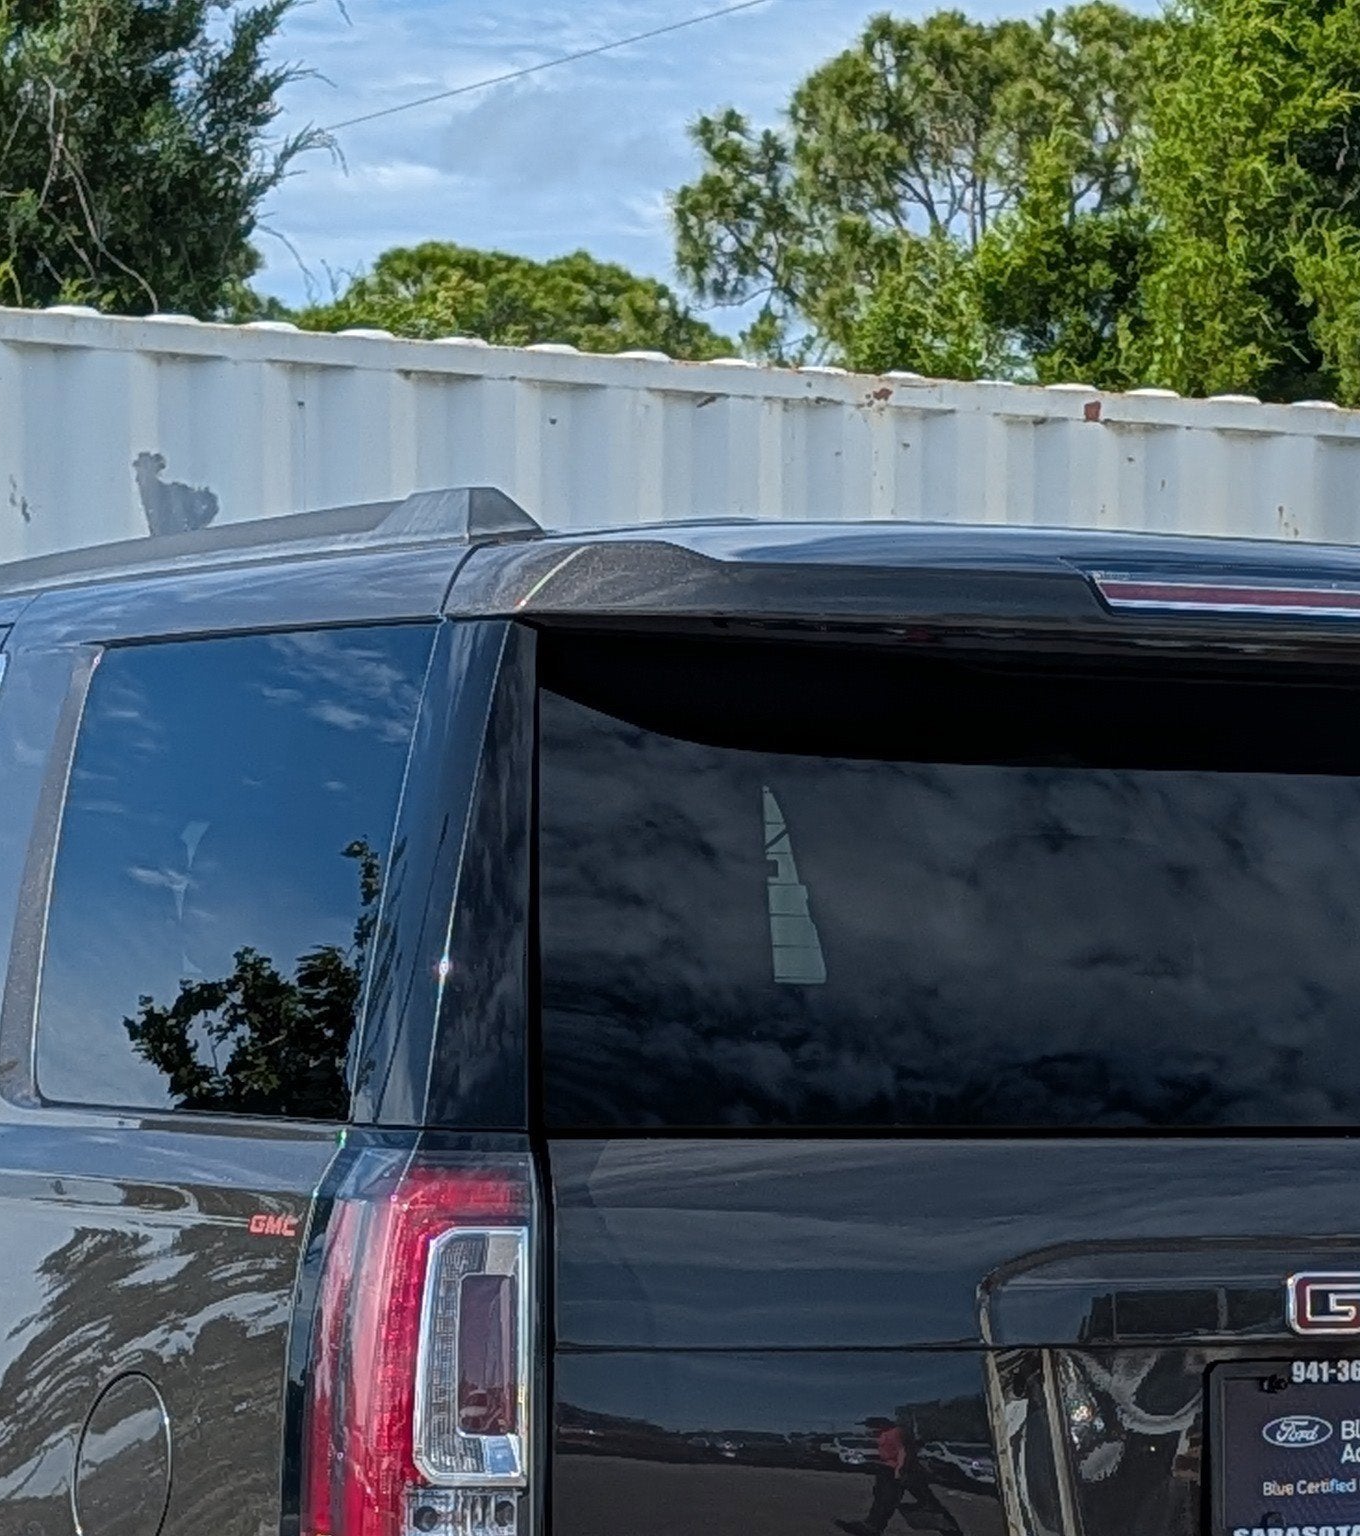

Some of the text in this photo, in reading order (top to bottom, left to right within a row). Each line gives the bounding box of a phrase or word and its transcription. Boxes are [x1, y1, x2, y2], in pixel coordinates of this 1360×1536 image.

[249, 1214, 299, 1237] GMC
[1263, 1480, 1294, 1496] Blue
[1296, 1478, 1356, 1495] Certified
